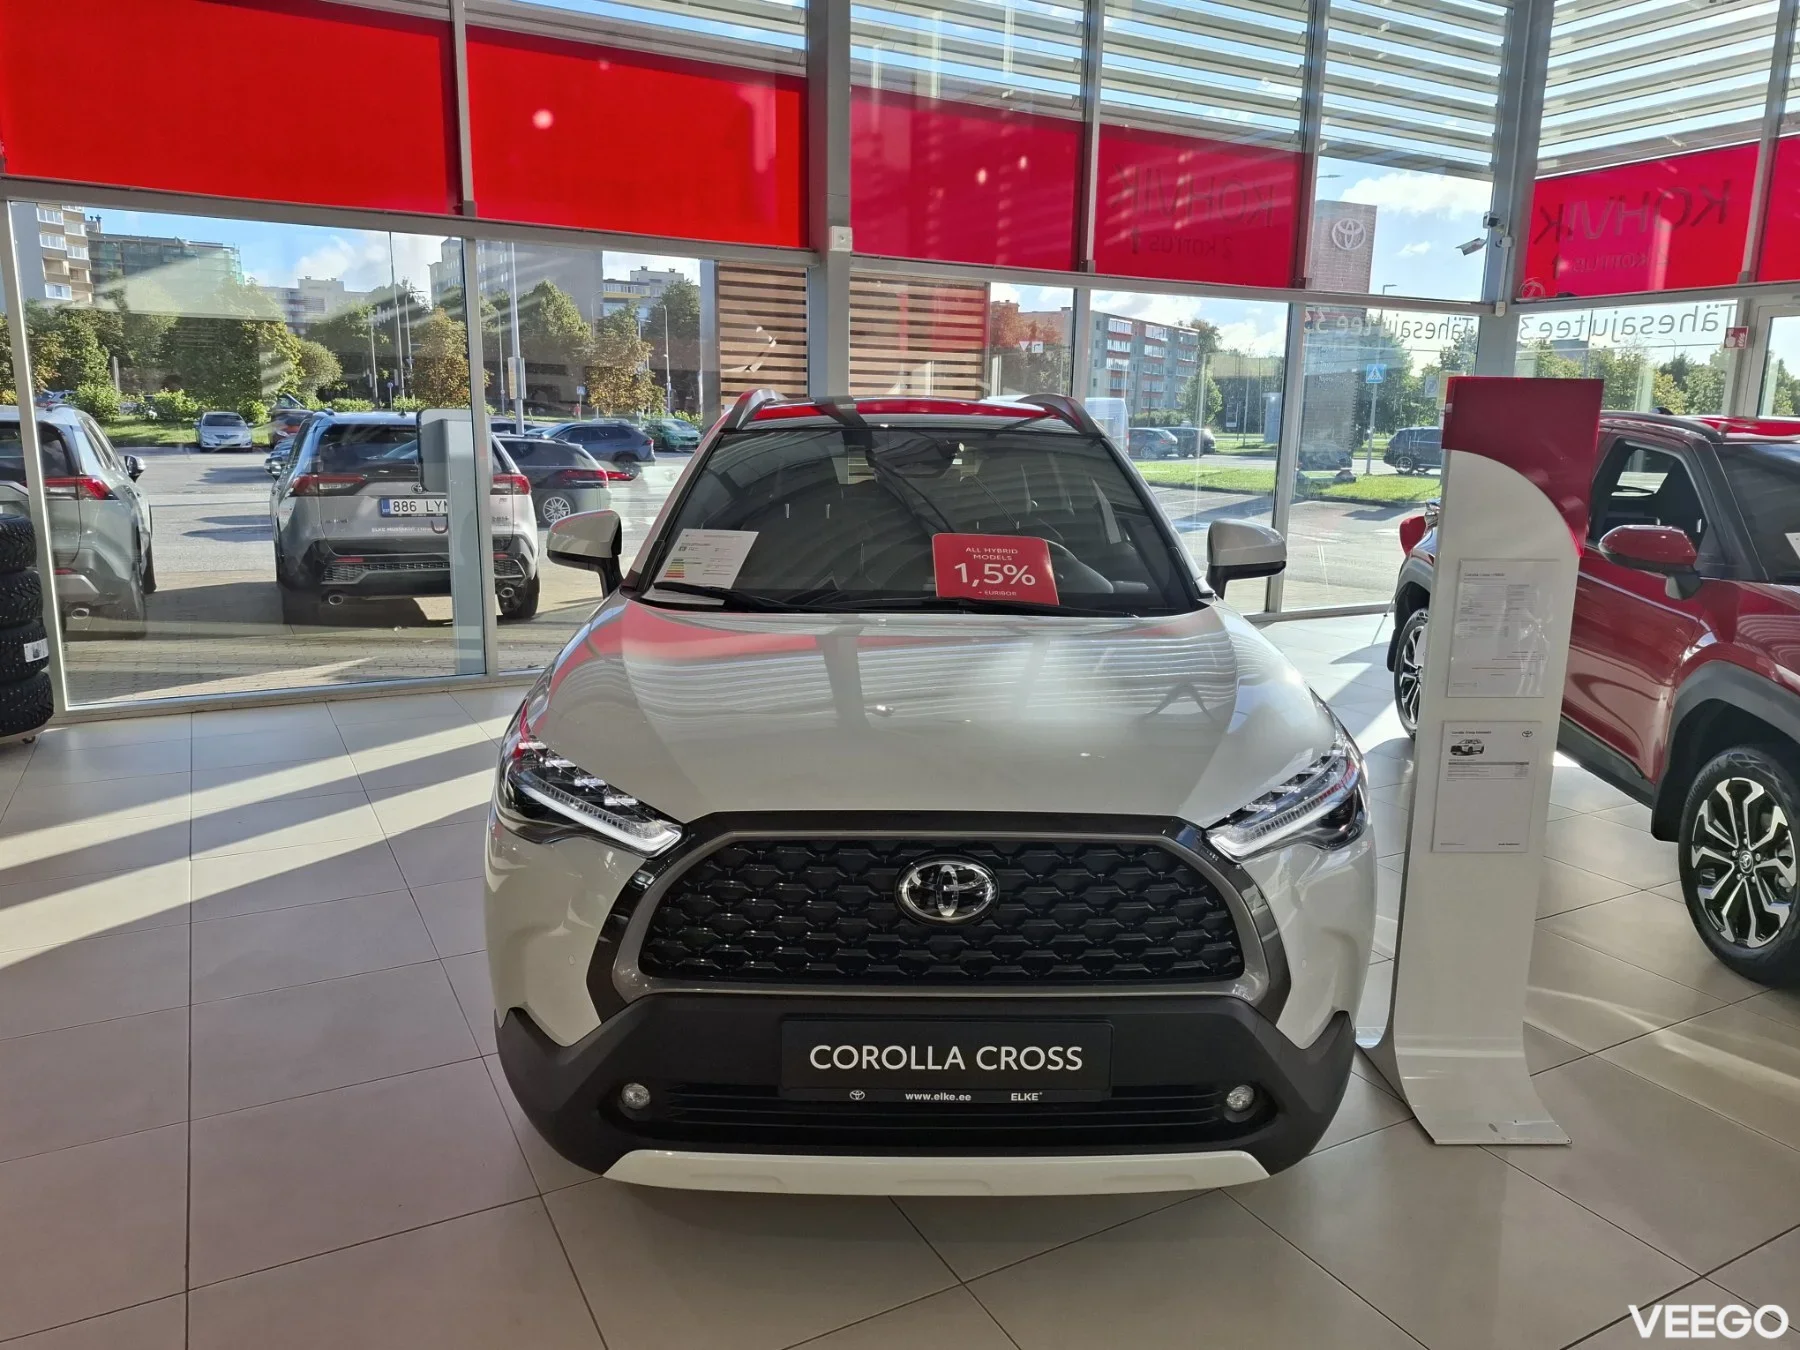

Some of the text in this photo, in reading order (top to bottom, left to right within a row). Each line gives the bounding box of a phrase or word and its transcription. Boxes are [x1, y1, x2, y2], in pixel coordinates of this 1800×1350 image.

[392, 500, 417, 513] 886
[954, 562, 1036, 588] 1,5%
[809, 1044, 1083, 1071] COROLLA CROSS
[905, 1091, 972, 1101] www.elke.ee
